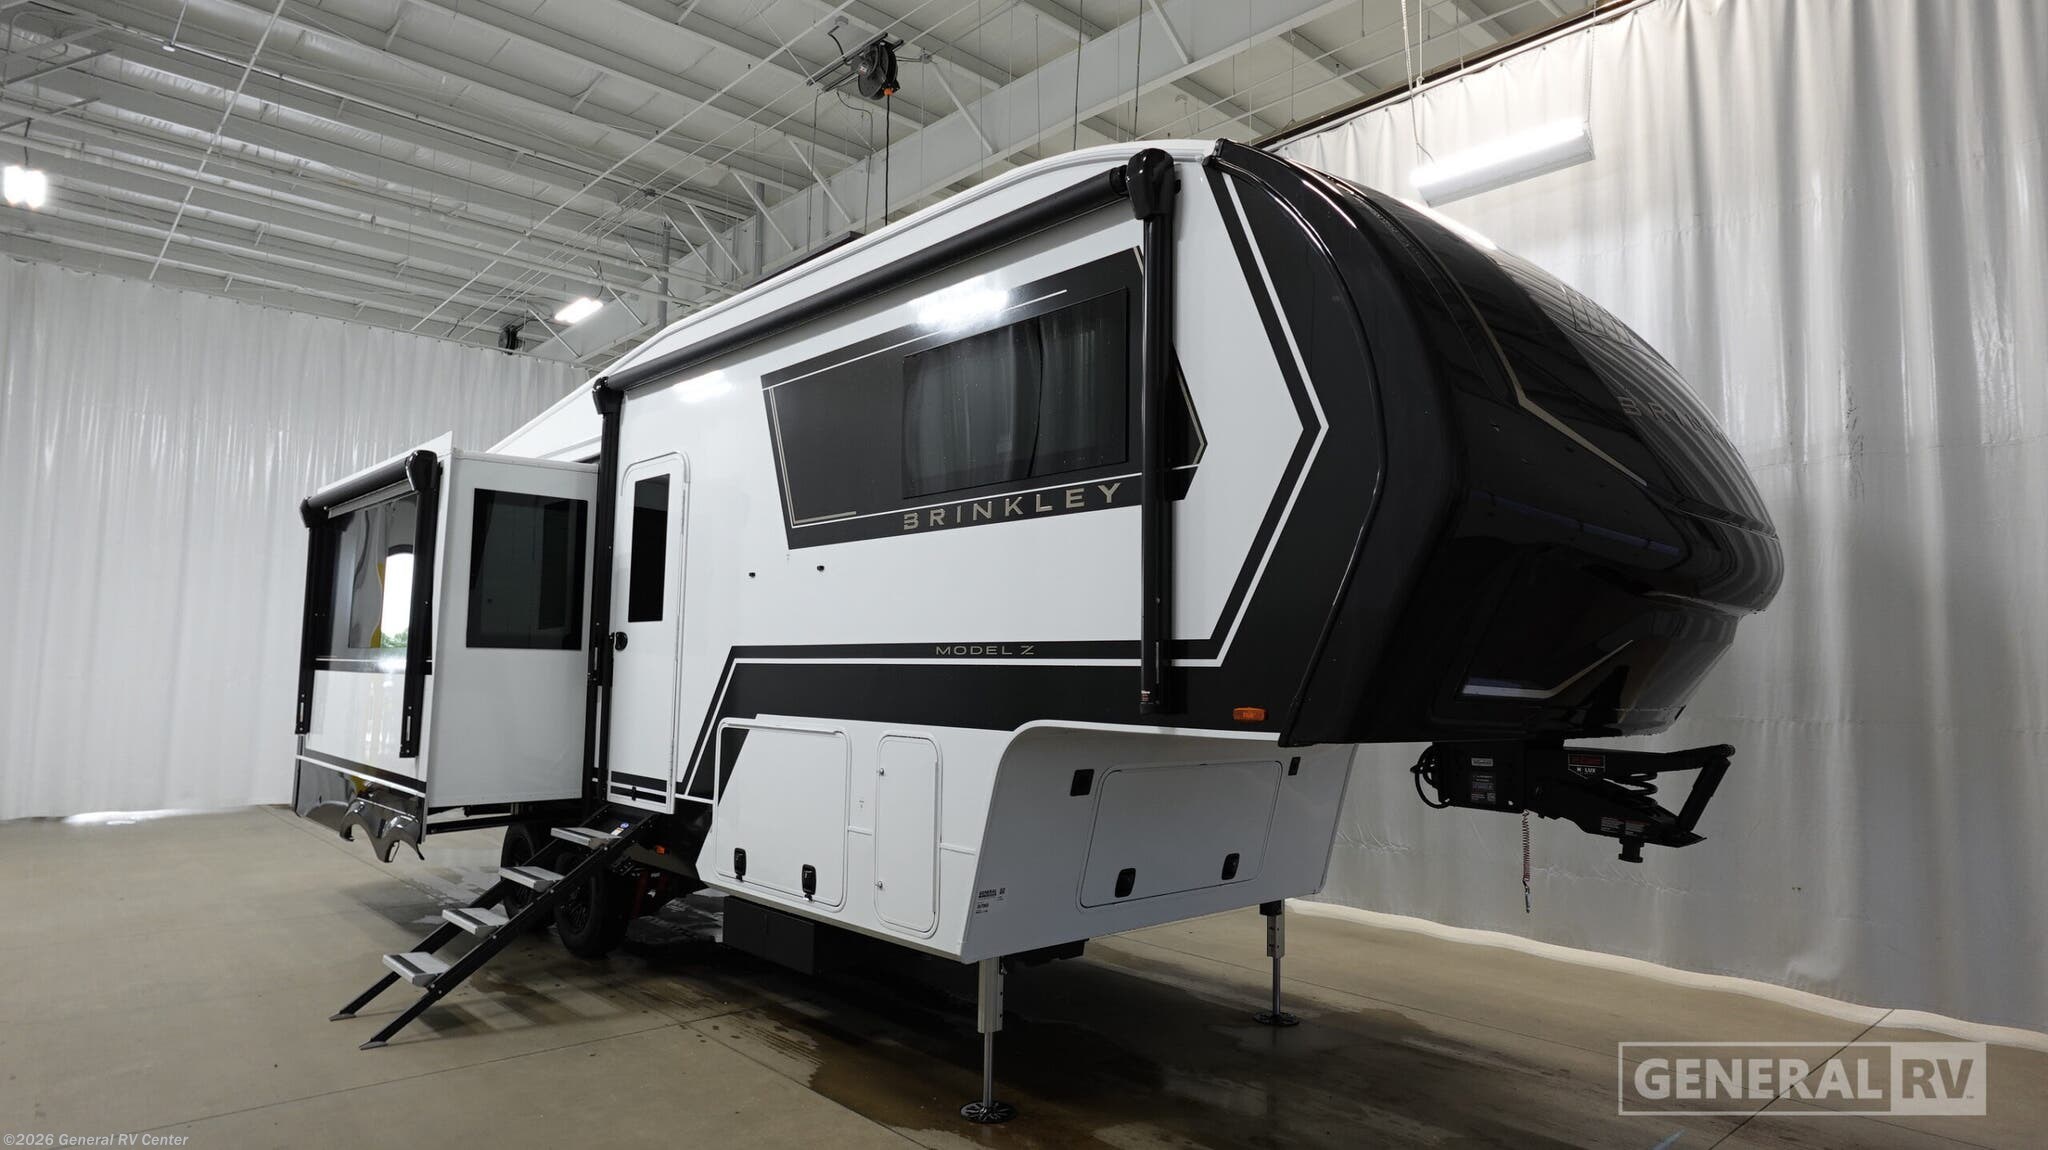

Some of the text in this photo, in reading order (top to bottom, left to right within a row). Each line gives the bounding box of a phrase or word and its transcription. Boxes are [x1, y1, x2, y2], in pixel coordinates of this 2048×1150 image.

[903, 482, 1121, 531] BRINKLEY
[935, 645, 1035, 656] MODEL Z
